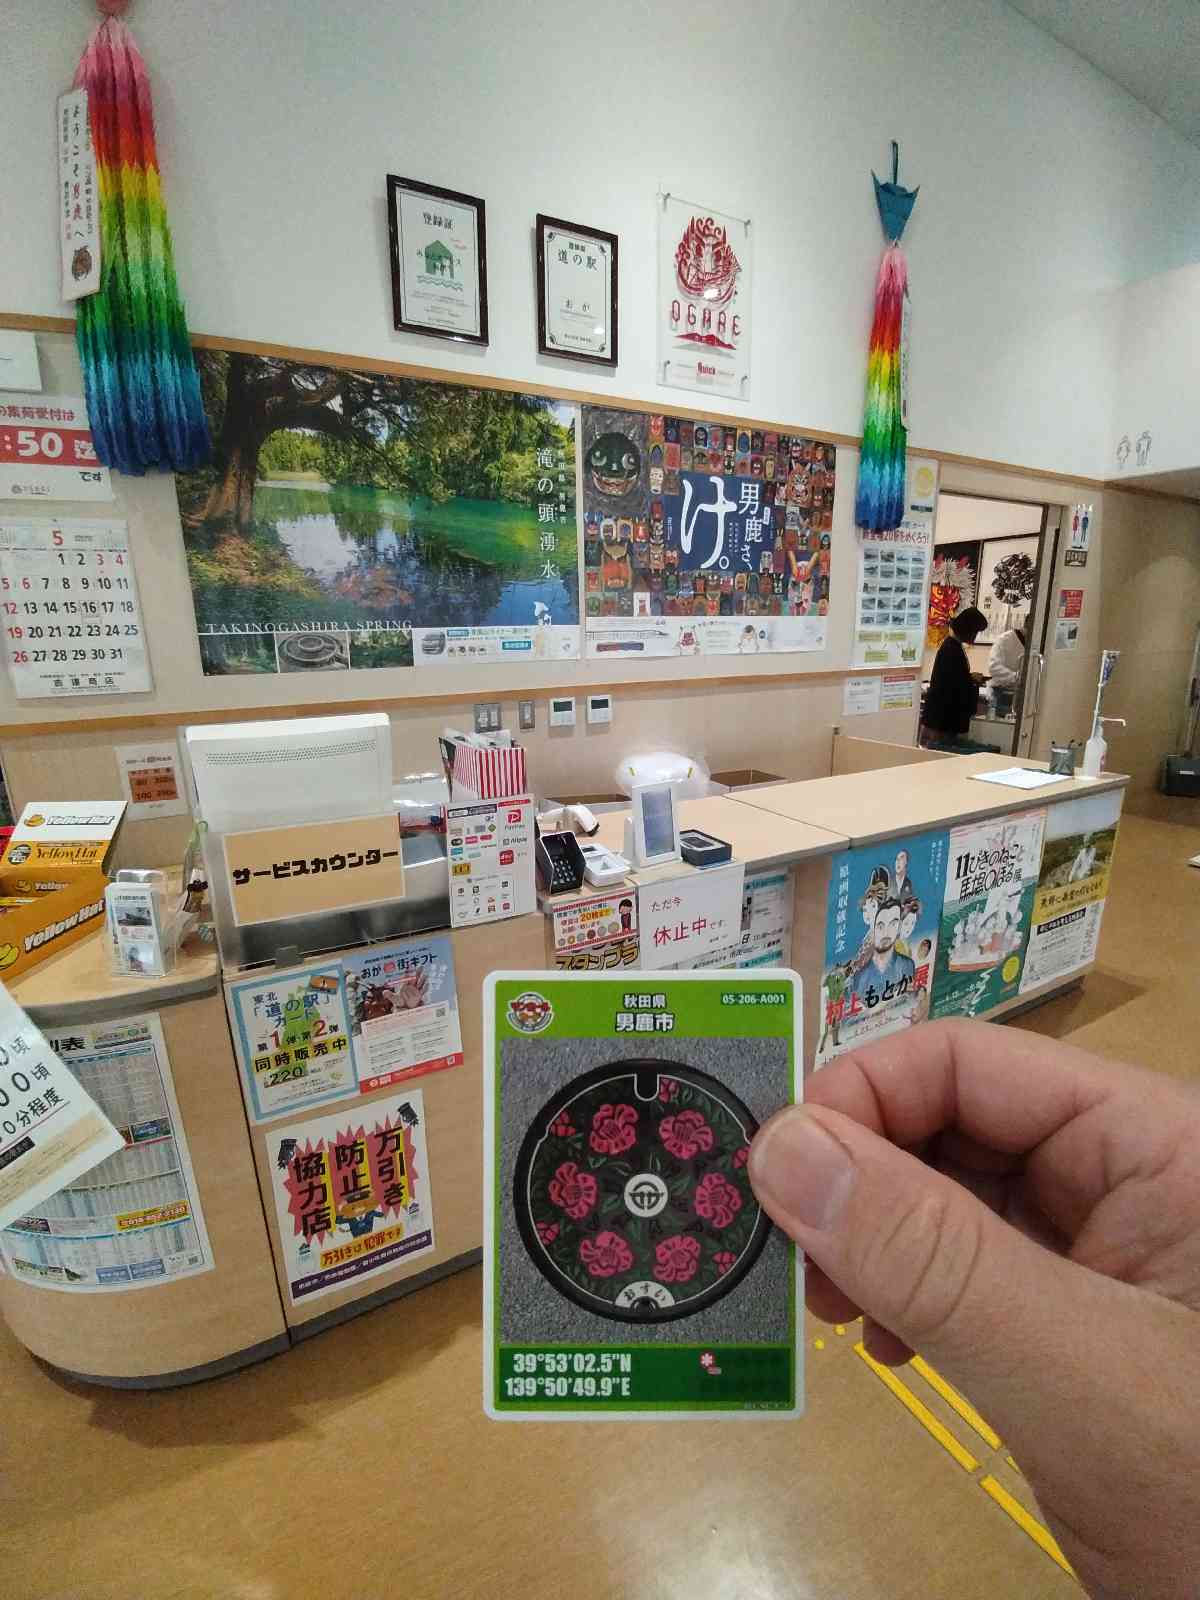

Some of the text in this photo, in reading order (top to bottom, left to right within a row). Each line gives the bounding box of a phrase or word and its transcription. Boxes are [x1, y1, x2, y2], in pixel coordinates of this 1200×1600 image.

[558, 249, 599, 271] 道の駅
[537, 446, 557, 579] 滝の頭湧水
[681, 475, 739, 569] け。
[52, 530, 64, 545] 5
[58, 553, 124, 565] 1 2 3 4
[1, 578, 129, 590] 5 6 7 8 9 10 11
[3, 601, 134, 615] 12 13 14 15 16 17 18
[8, 624, 139, 639] 19 20 21 22 23 24 25
[356, 619, 413, 632] SPRING
[13, 648, 123, 663] 26 27 28 29 30 31
[46, 816, 88, 826] Yellow
[36, 848, 74, 859] Yellow
[73, 847, 98, 859] Hat
[232, 848, 400, 886] サービスカウンター
[649, 896, 683, 912] ただ今
[24, 898, 106, 953] Yellow Hat
[253, 991, 278, 1005] 東北
[623, 993, 666, 1008] 秋田県
[722, 993, 785, 1005] 05-206-A001
[825, 963, 930, 1026] 村上もとか展
[275, 1008, 314, 1028] カード
[615, 1012, 675, 1031] 男鹿市
[254, 1038, 347, 1072] 同時販売中
[0, 1087, 65, 1143] 0分程度
[335, 1140, 371, 1197] 防止
[374, 1126, 407, 1206] 万引き
[293, 1151, 332, 1237] 協力店
[623, 1282, 666, 1301] おすい
